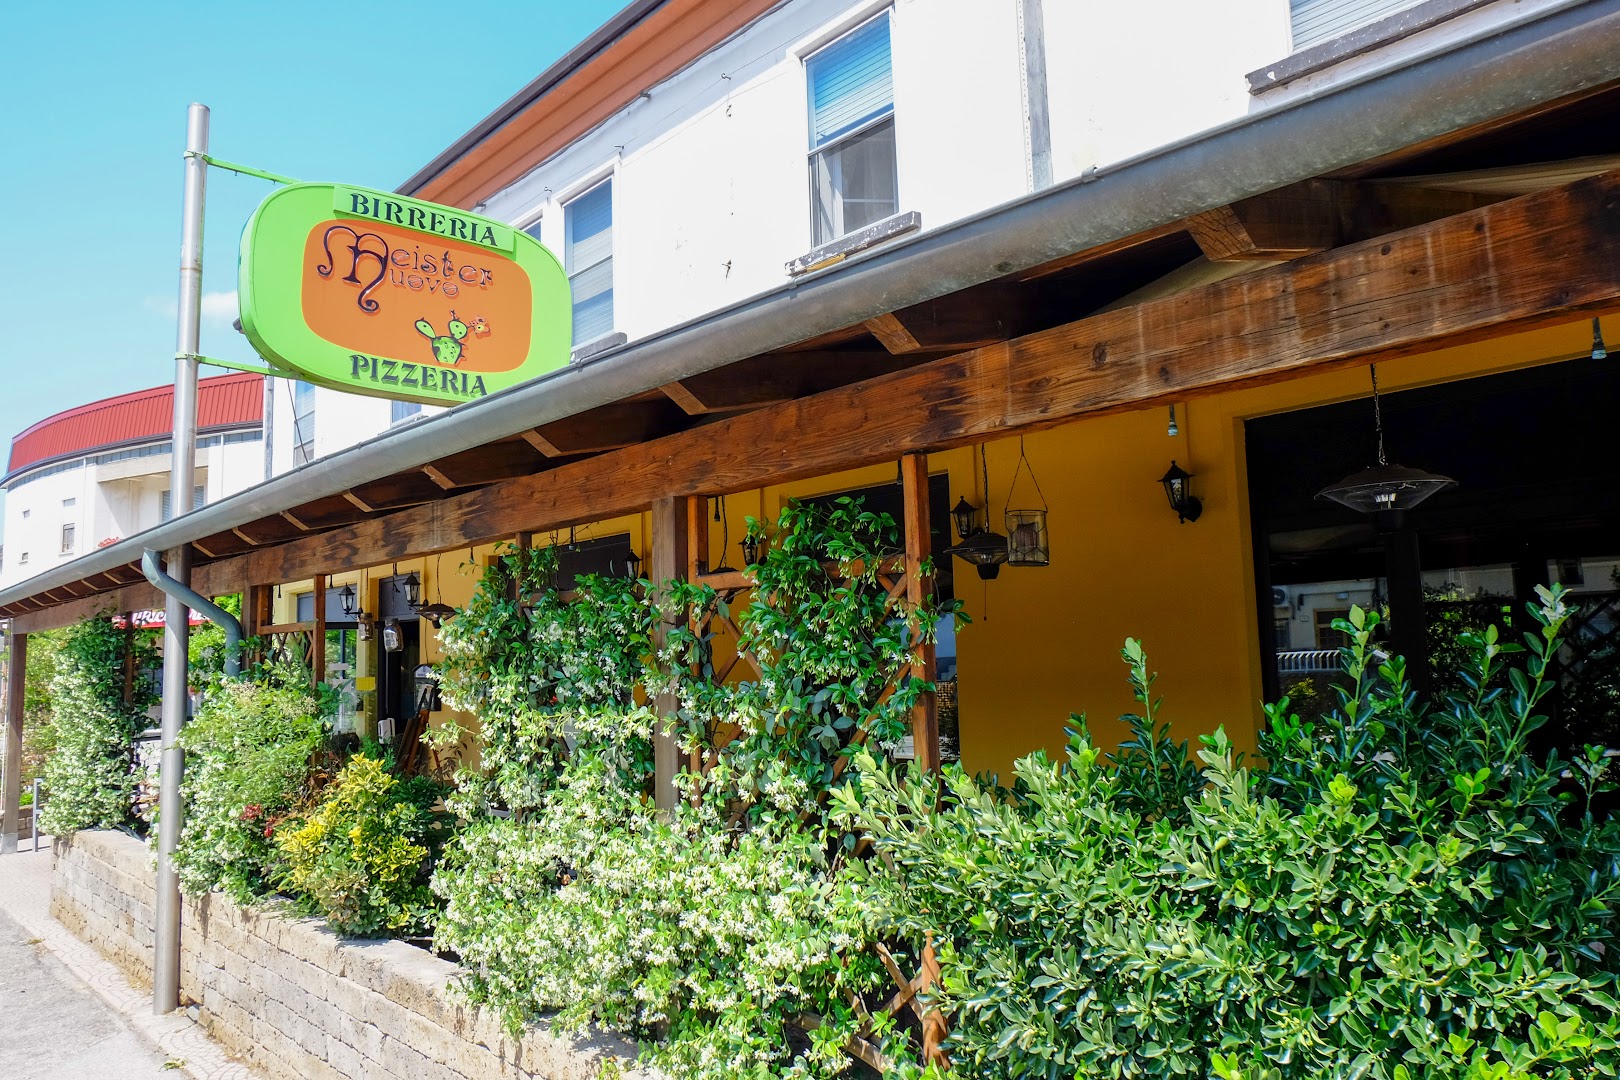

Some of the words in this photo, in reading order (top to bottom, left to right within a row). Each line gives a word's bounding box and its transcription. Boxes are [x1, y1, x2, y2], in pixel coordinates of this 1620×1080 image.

[350, 193, 498, 247] BIRRERIA
[317, 225, 493, 312] Meister
[349, 354, 488, 397] PIZZERIA
